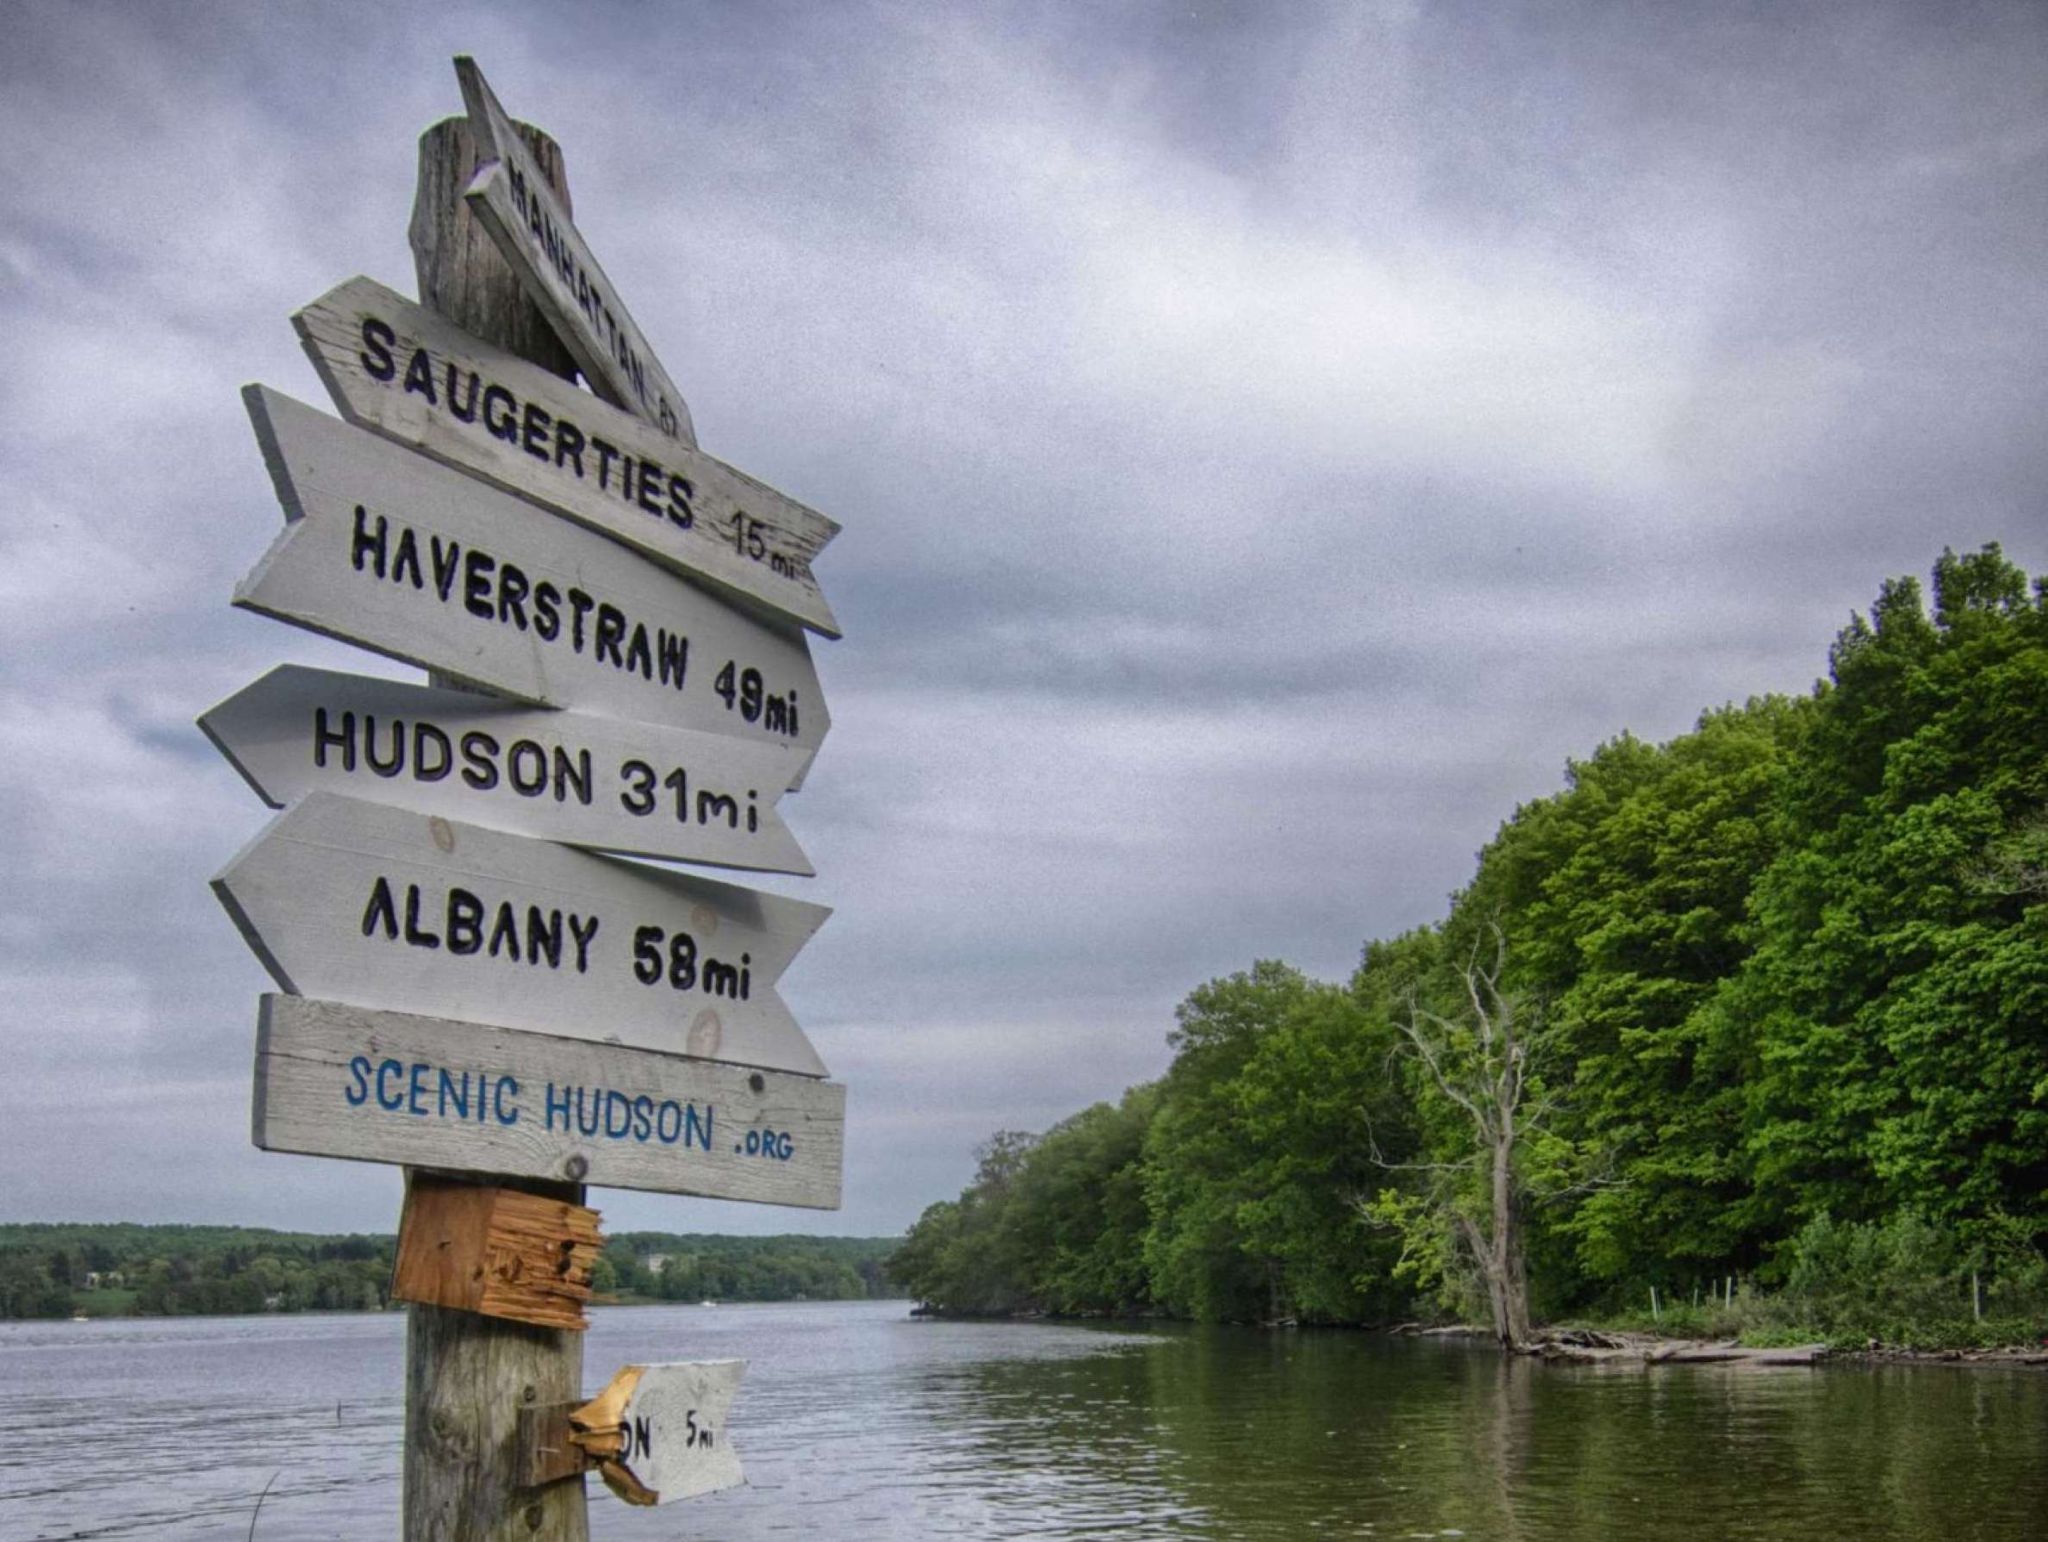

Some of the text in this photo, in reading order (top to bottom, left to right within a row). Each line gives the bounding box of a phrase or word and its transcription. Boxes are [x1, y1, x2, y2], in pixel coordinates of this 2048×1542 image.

[360, 317, 694, 530] SAUGERTIES
[730, 510, 767, 562] 15
[350, 505, 689, 690] HAVERSTRAW
[314, 708, 594, 806] HUDSON
[361, 876, 599, 974] ALBANY
[345, 1055, 520, 1127] SCENIC
[546, 1083, 713, 1152] HUDSON
